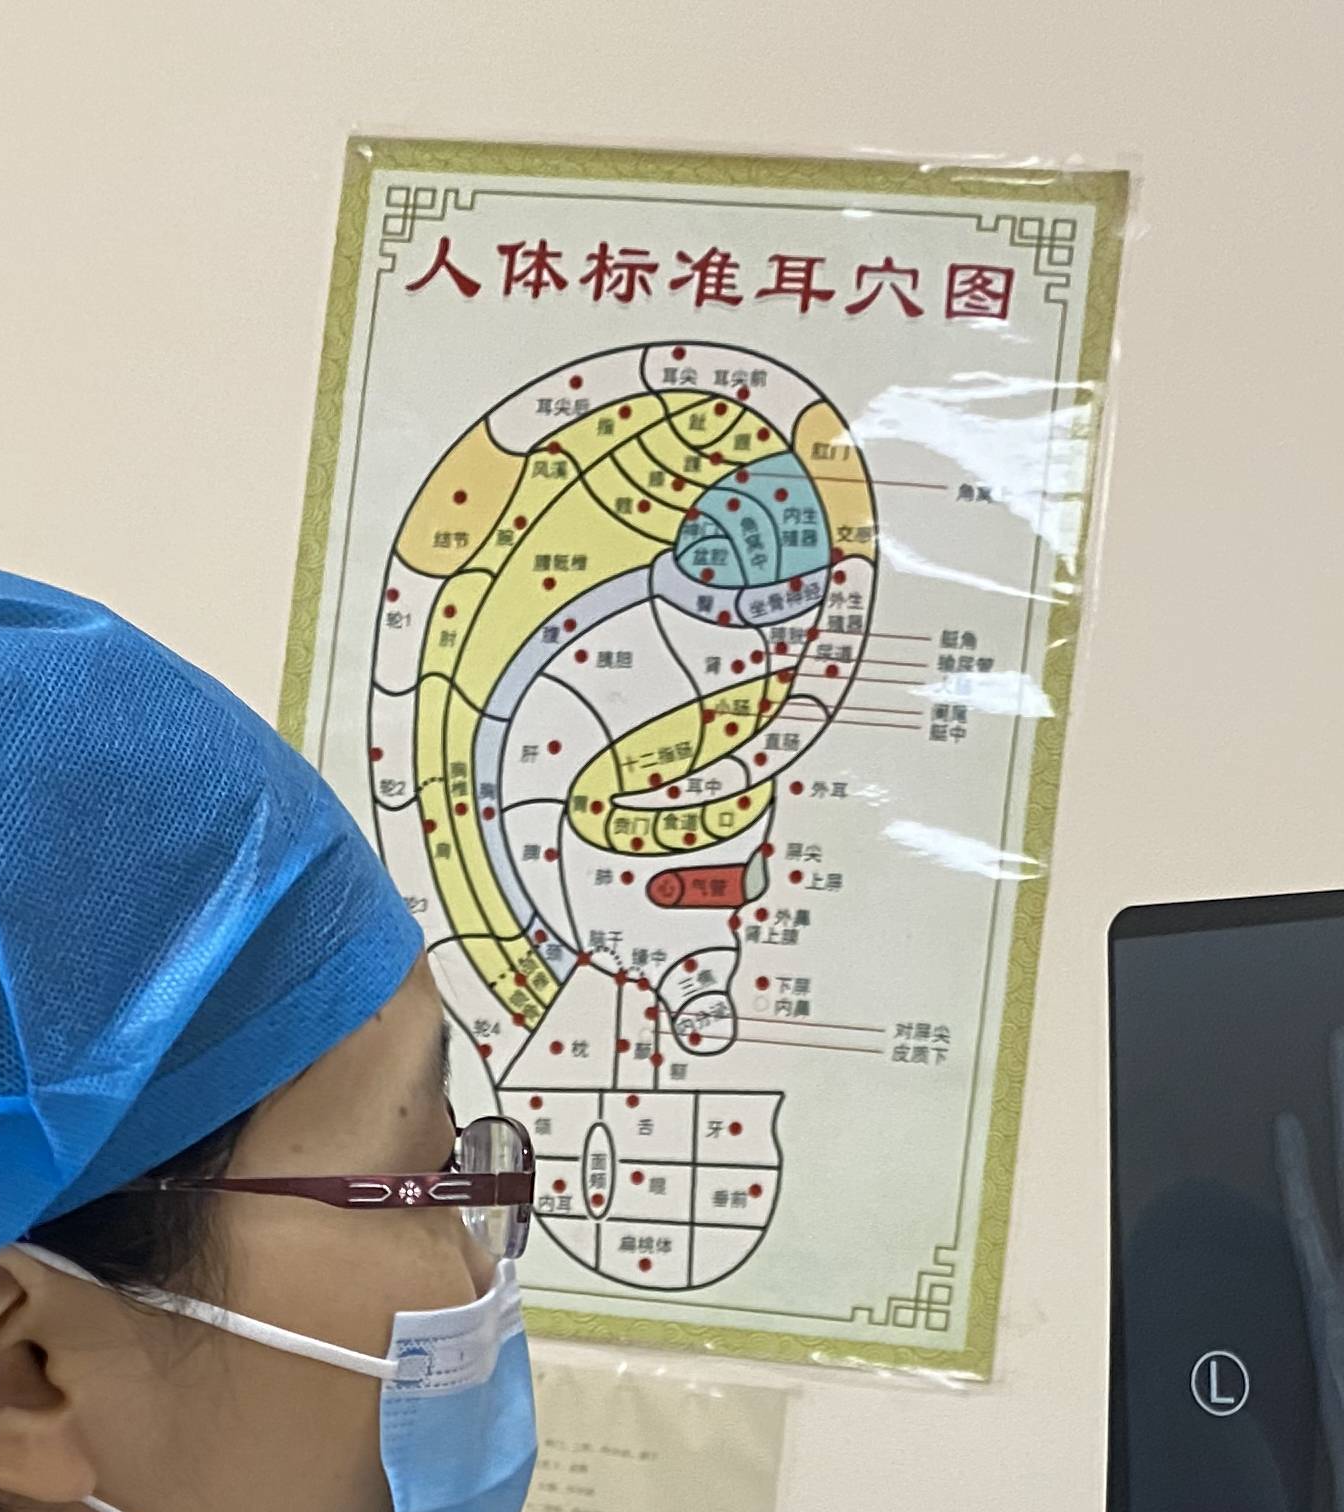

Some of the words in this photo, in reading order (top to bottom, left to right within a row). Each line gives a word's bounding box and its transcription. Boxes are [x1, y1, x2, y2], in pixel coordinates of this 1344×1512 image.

[406, 237, 1017, 322] 人体标准耳穴图
[662, 367, 698, 386] 耳尖
[809, 781, 849, 799] 外耳
